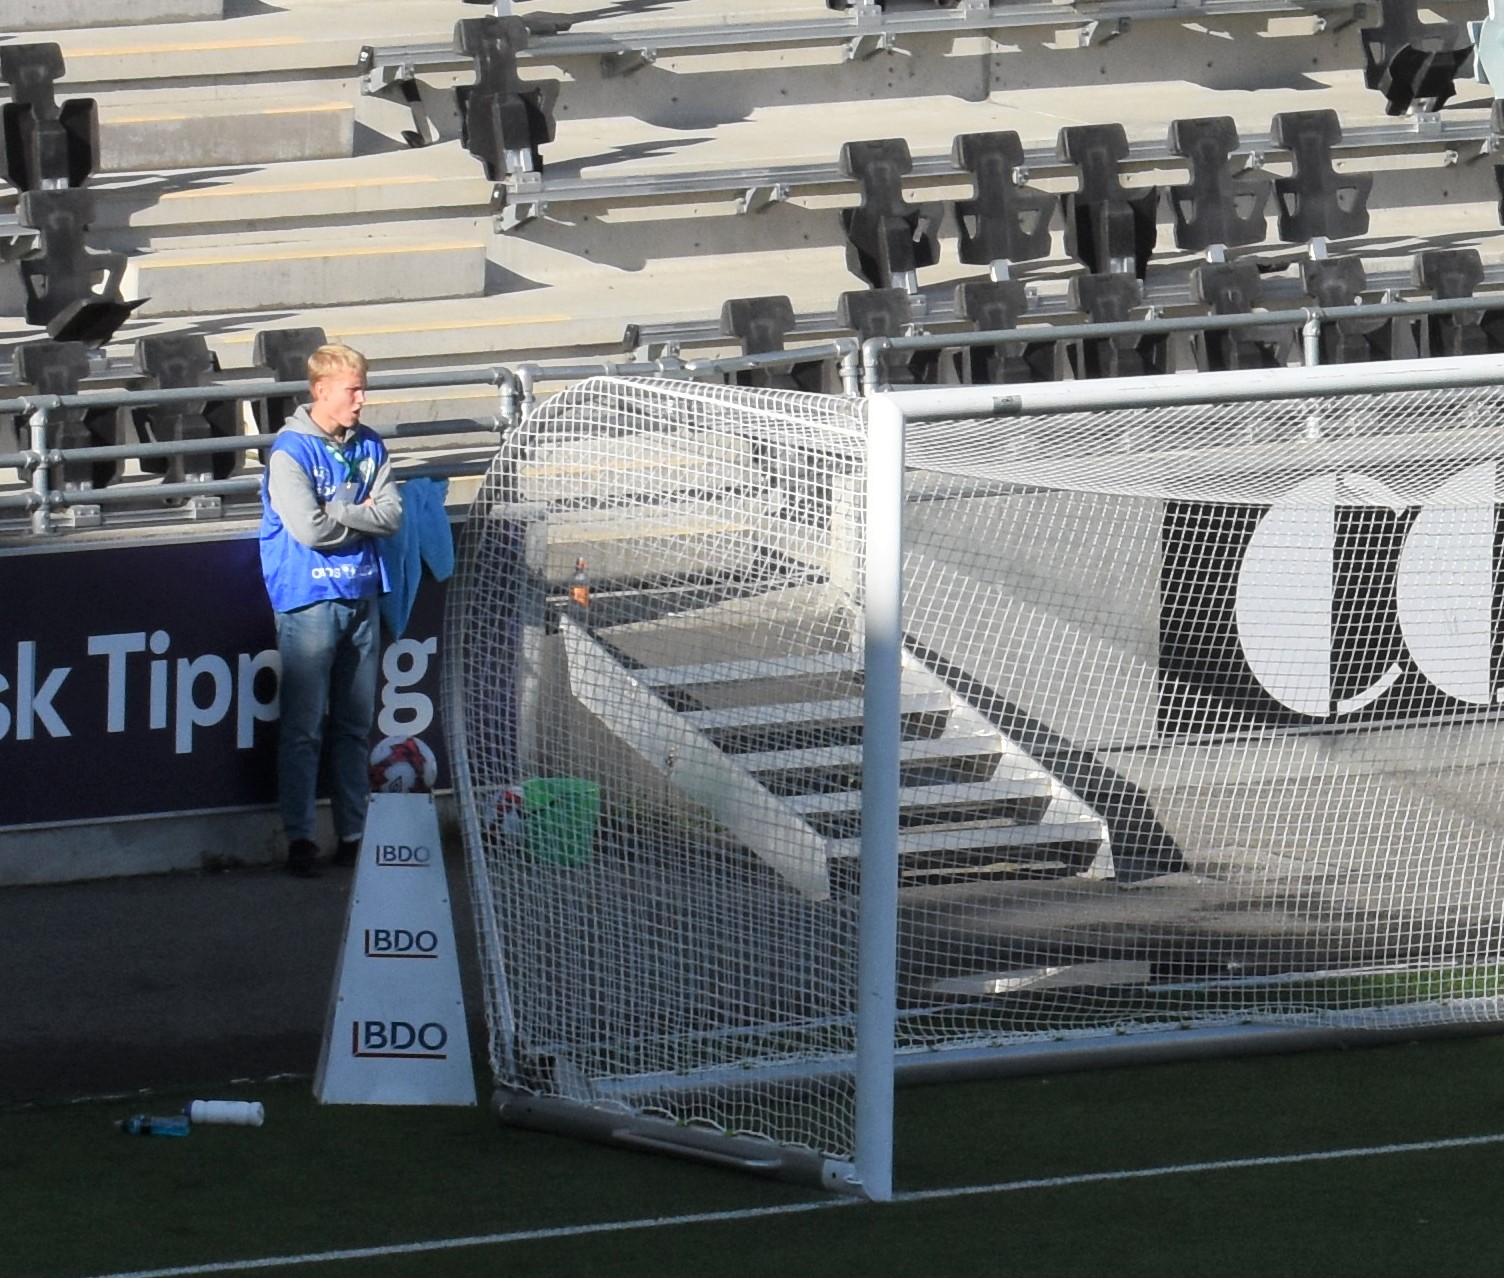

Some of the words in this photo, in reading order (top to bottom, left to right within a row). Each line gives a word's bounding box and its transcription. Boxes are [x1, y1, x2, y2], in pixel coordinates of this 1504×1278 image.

[0, 640, 72, 743] k
[87, 629, 438, 755] Tippg
[382, 844, 431, 863] BDO
[373, 928, 438, 952] BDO
[363, 1020, 448, 1051] BDO
